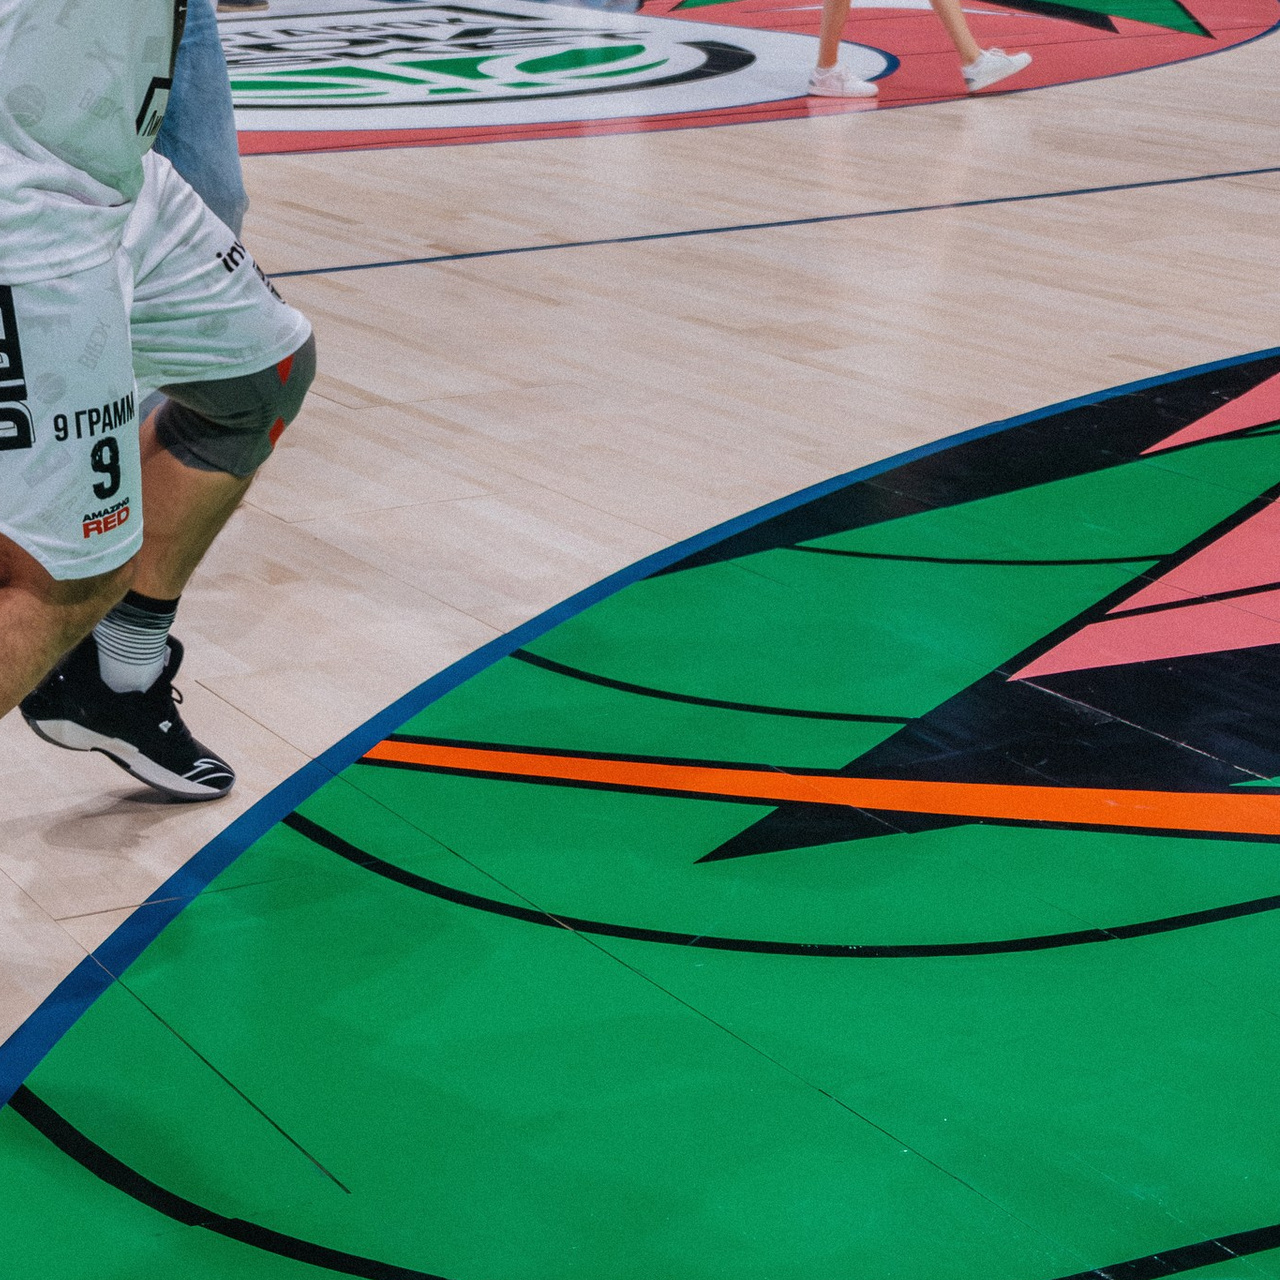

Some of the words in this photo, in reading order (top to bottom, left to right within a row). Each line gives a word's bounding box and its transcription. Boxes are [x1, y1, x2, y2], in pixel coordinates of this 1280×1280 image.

[53, 413, 69, 442] 9
[74, 391, 135, 439] ГРАММ
[91, 436, 121, 500] 9
[82, 497, 130, 523] AMAZING
[82, 506, 130, 539] RED
